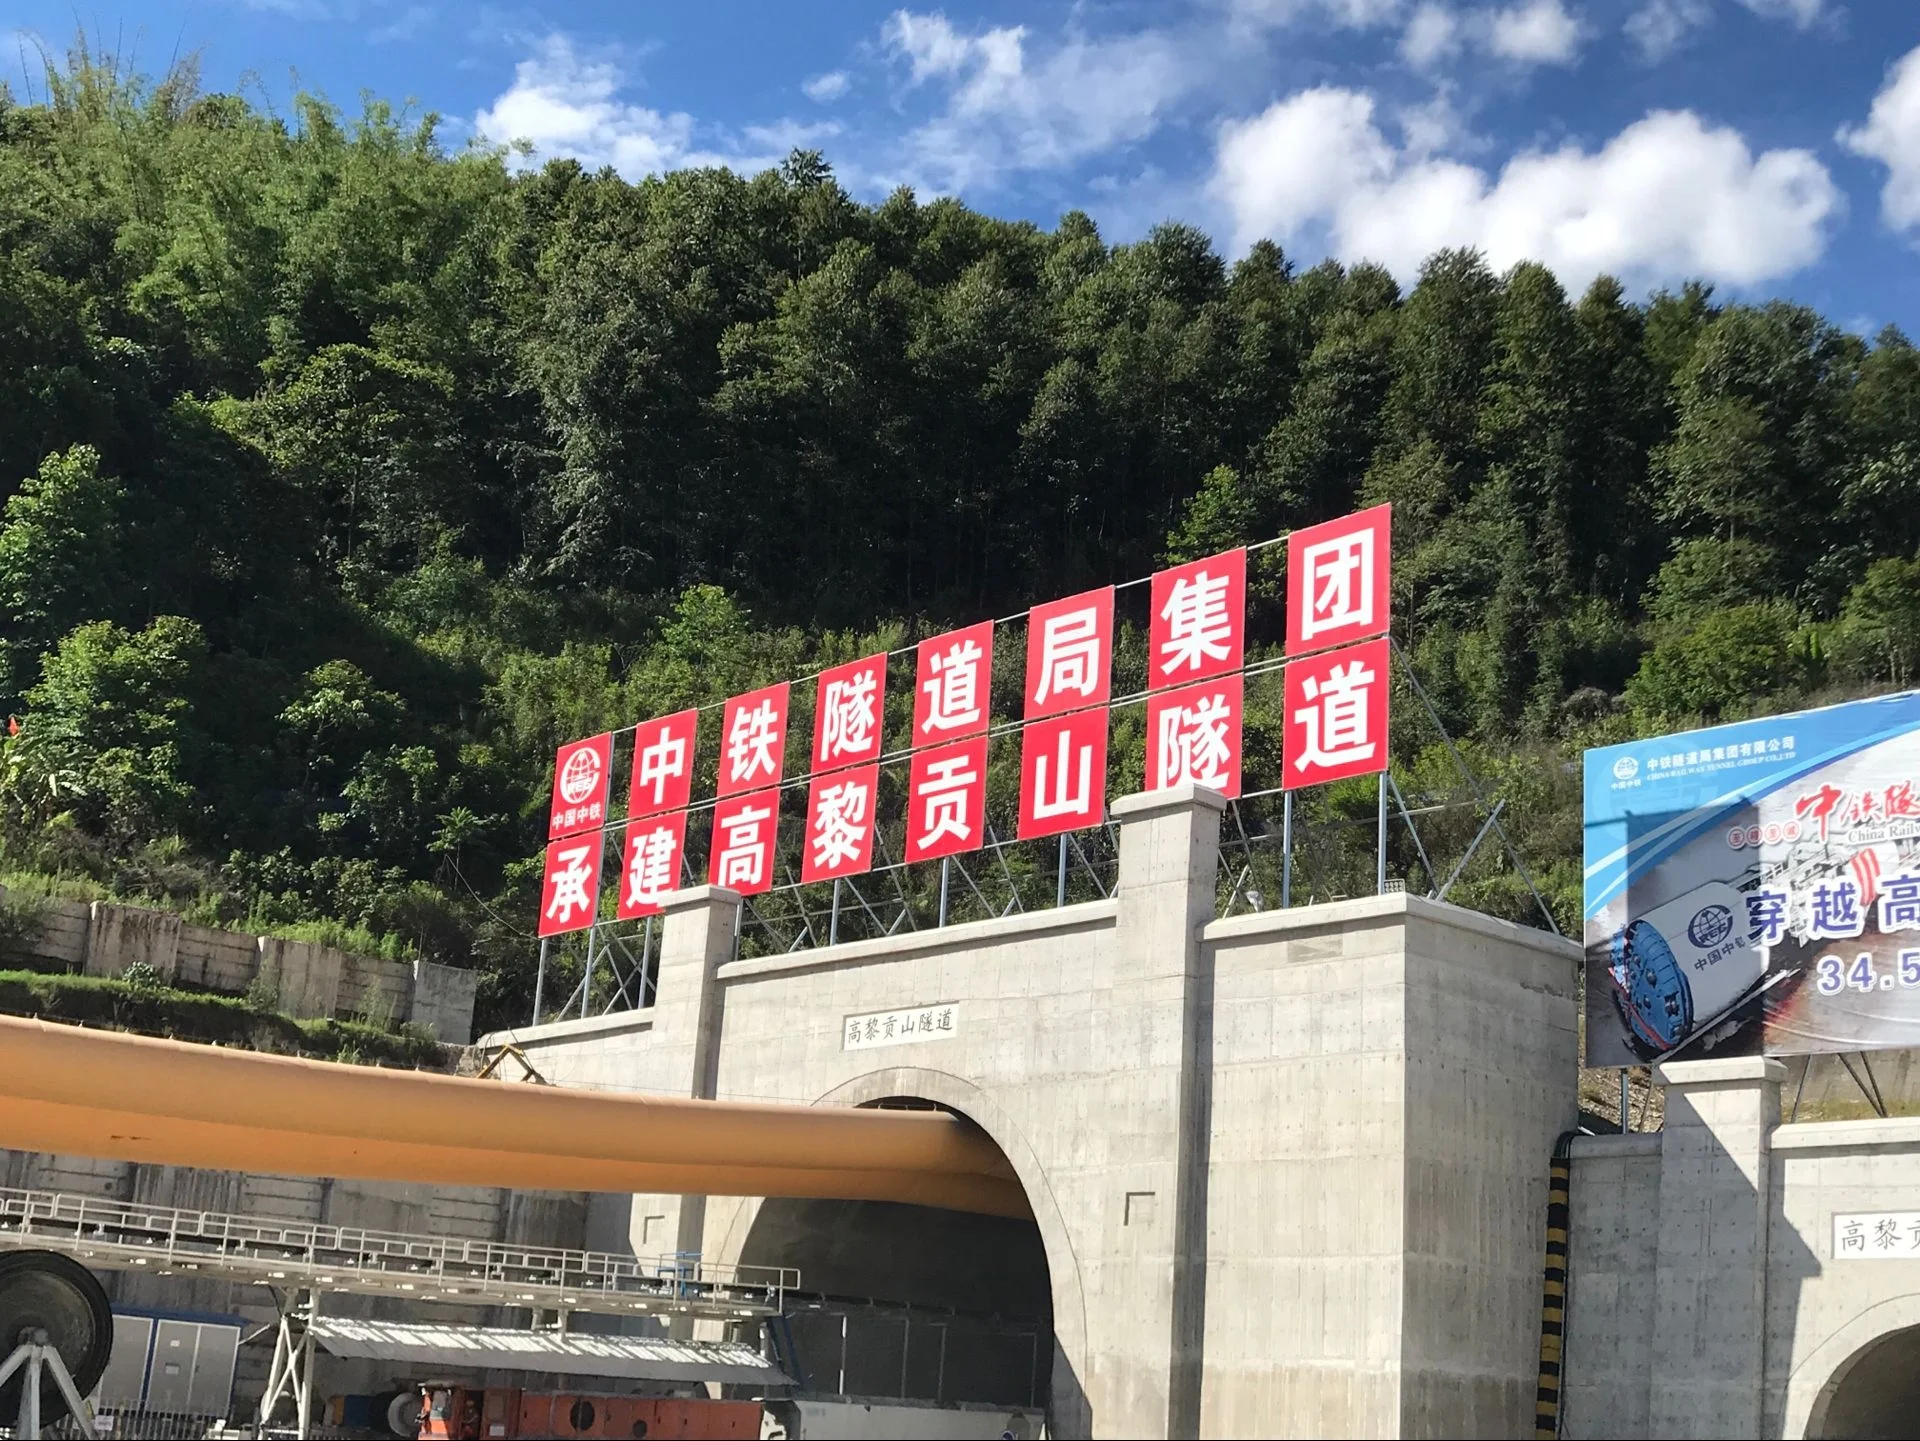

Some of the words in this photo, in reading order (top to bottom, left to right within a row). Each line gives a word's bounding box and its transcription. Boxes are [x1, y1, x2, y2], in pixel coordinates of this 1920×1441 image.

[639, 527, 1377, 805] 中铁隧道局集团
[1647, 736, 1795, 771] 中铁隧道局集团有限公司
[547, 662, 1378, 925] 承建高黎贡山隧道
[552, 802, 601, 830] 中国中铁
[1848, 829, 1885, 843] China
[1745, 874, 1920, 941] 穿越高
[1820, 951, 1920, 991] 34.5
[848, 1008, 953, 1044] 高黎贡山隧道
